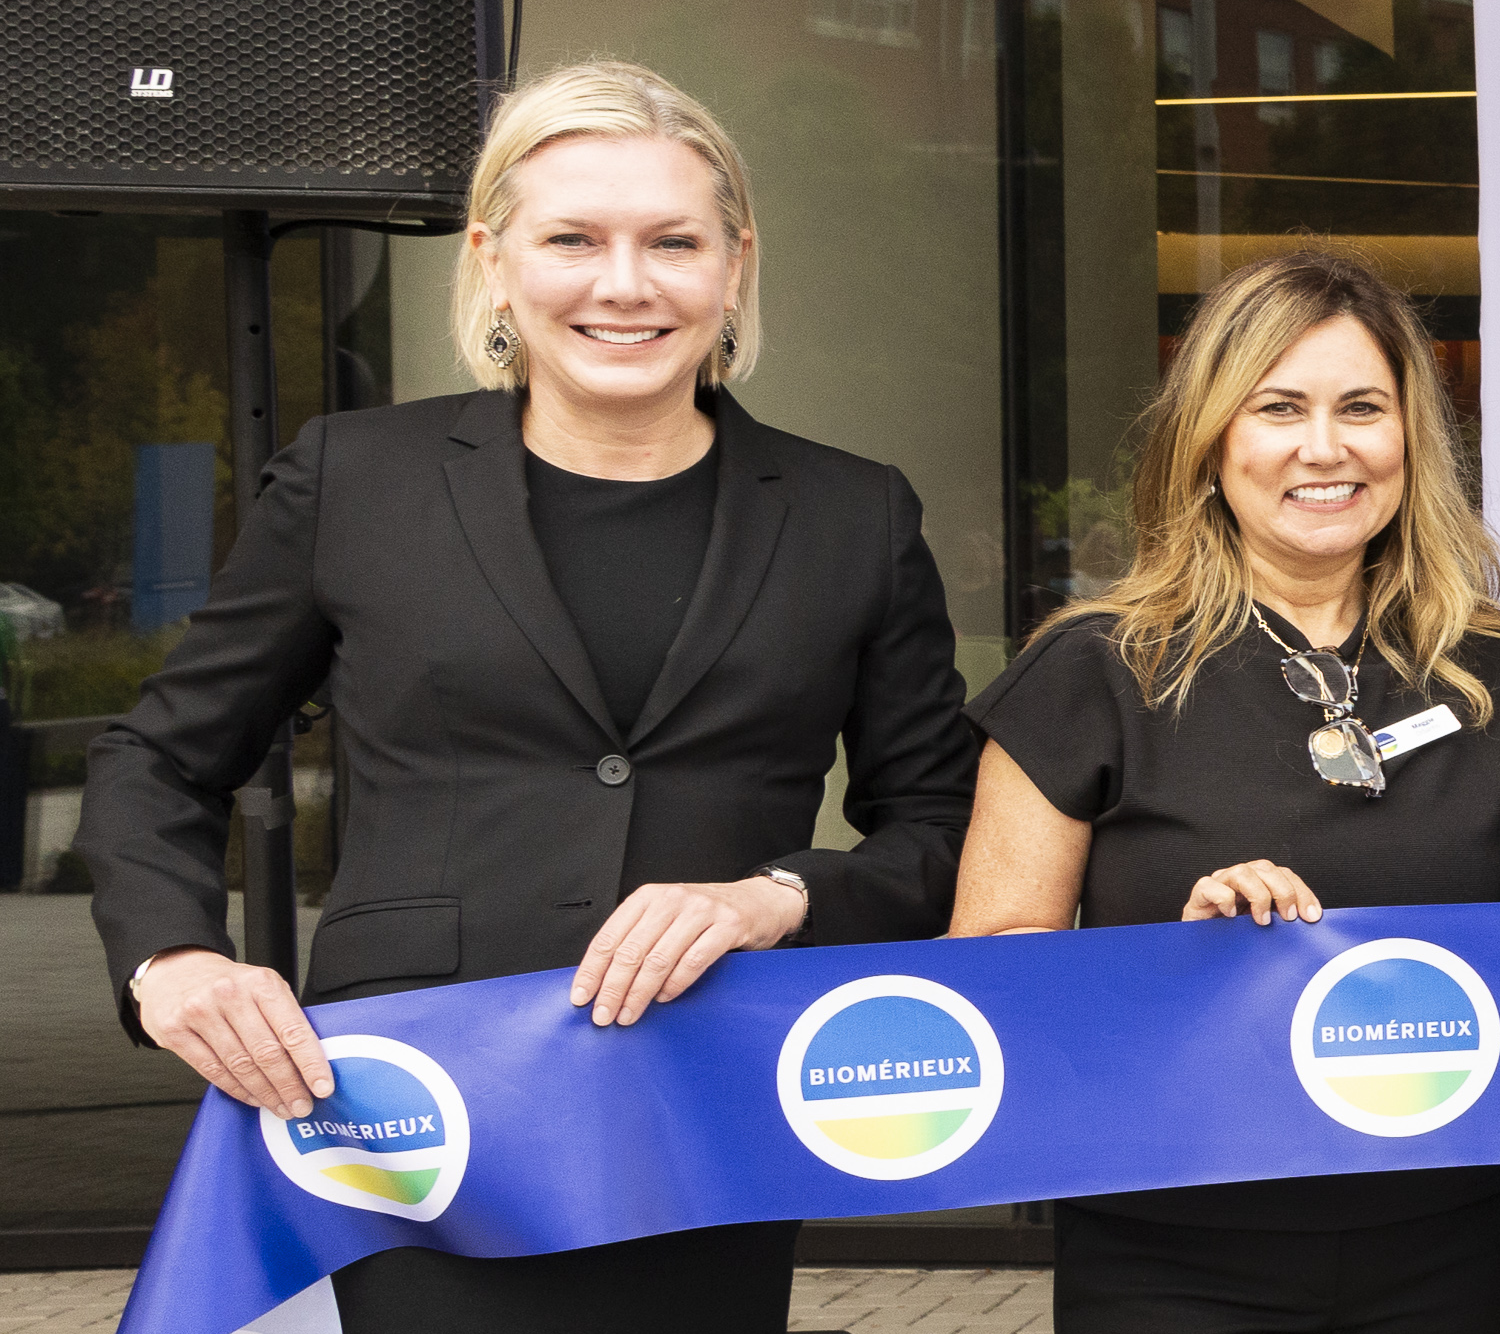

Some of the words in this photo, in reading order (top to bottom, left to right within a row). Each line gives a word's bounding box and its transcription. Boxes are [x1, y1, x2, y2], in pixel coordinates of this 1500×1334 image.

[130, 68, 173, 90] LD
[1320, 1020, 1472, 1044] BIOMÉRIEUX
[808, 1057, 973, 1086] BIOMÉRIEUX
